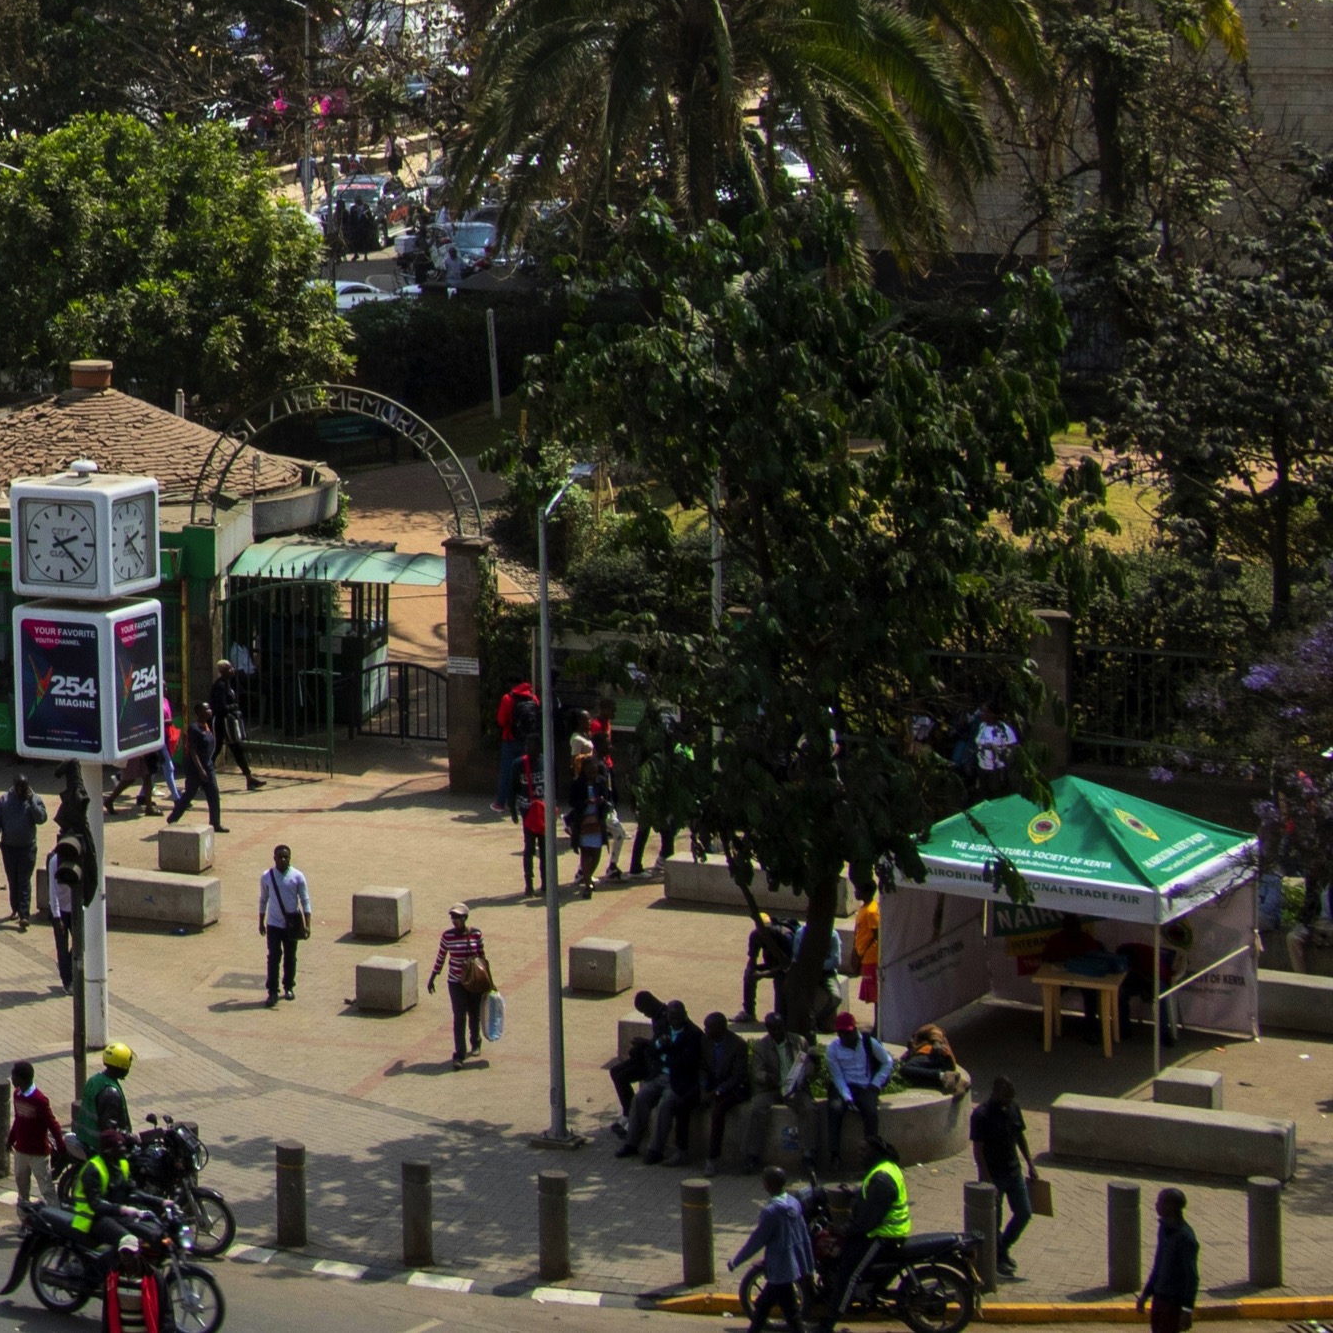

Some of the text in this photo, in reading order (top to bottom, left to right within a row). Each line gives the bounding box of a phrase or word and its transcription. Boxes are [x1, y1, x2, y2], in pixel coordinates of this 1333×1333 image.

[327, 390, 438, 454] MEMORIAL
[51, 527, 71, 536] CITY
[34, 626, 96, 639] YOUR FAVORITE
[121, 617, 157, 635] YOUR FAVORITE
[35, 637, 81, 646] YOUTH CHANNEL
[131, 665, 157, 691] 254
[50, 675, 97, 698] 254
[134, 687, 157, 702] IMAGINE
[54, 697, 96, 709] IMAGINE
[951, 839, 968, 850] THE
[969, 842, 1031, 858] AGRICULTURAL
[1031, 849, 1070, 863] SOCIETY
[1070, 856, 1083, 865] OF
[1083, 858, 1112, 869] KENYA
[1015, 857, 1059, 870] Exhibition
[927, 865, 967, 881] AIROBI
[1067, 886, 1111, 900] TRADE
[1112, 892, 1140, 905] FAIR
